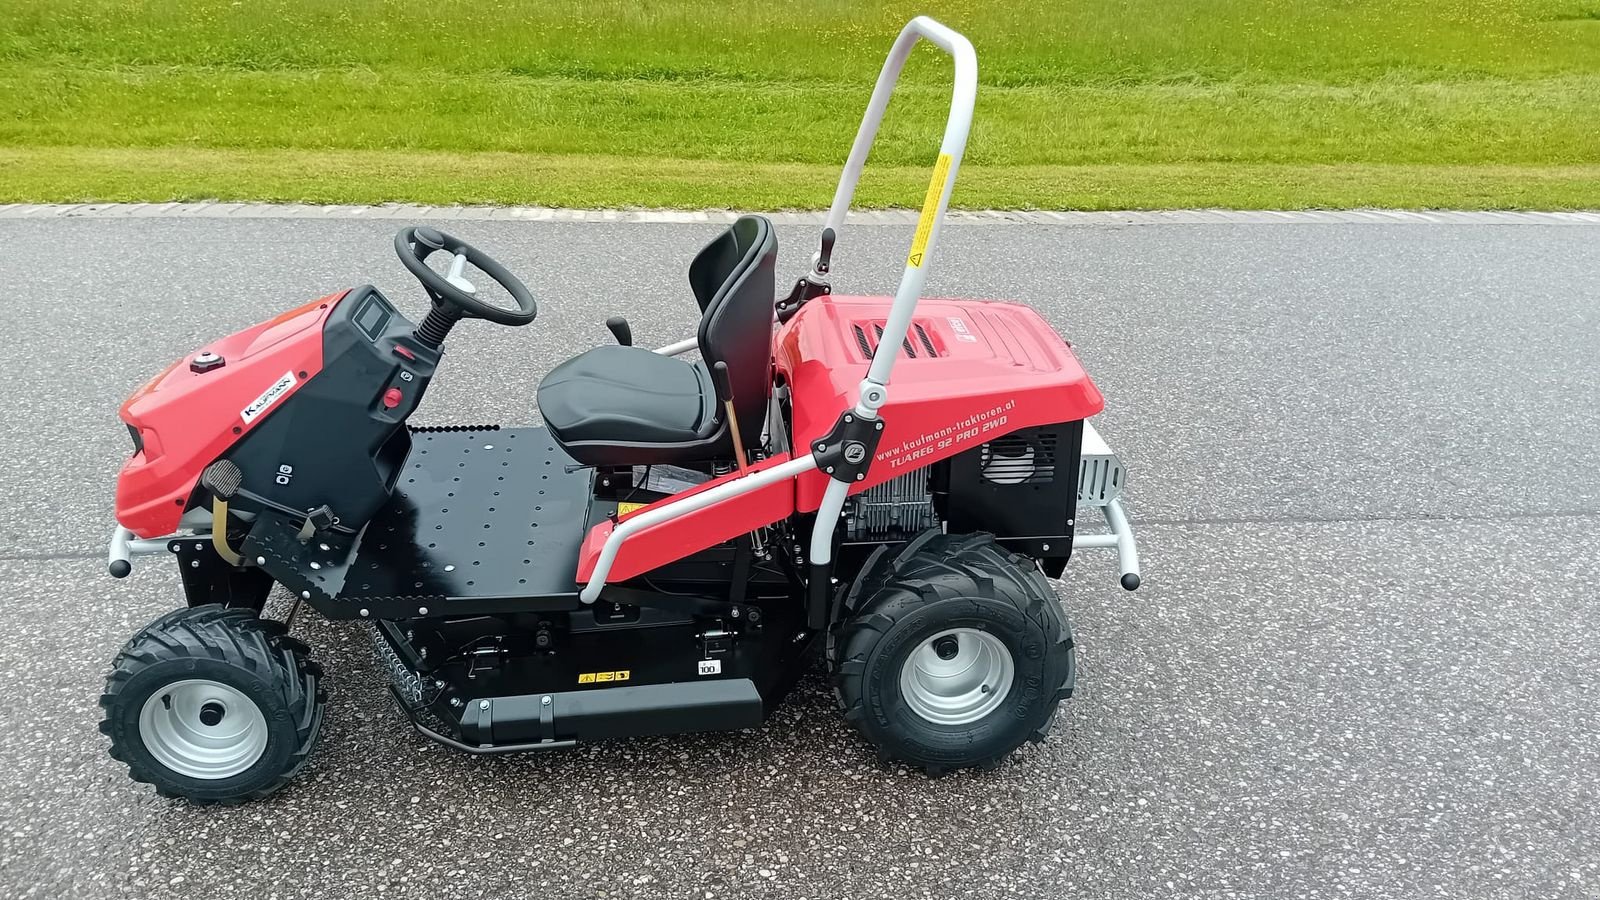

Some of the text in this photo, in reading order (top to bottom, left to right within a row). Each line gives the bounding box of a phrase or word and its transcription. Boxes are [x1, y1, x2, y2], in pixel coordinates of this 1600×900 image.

[877, 399, 1016, 462] www.kaufmann-traktoren.at
[890, 415, 1008, 468] TUAREG 92 PRO 2WD
